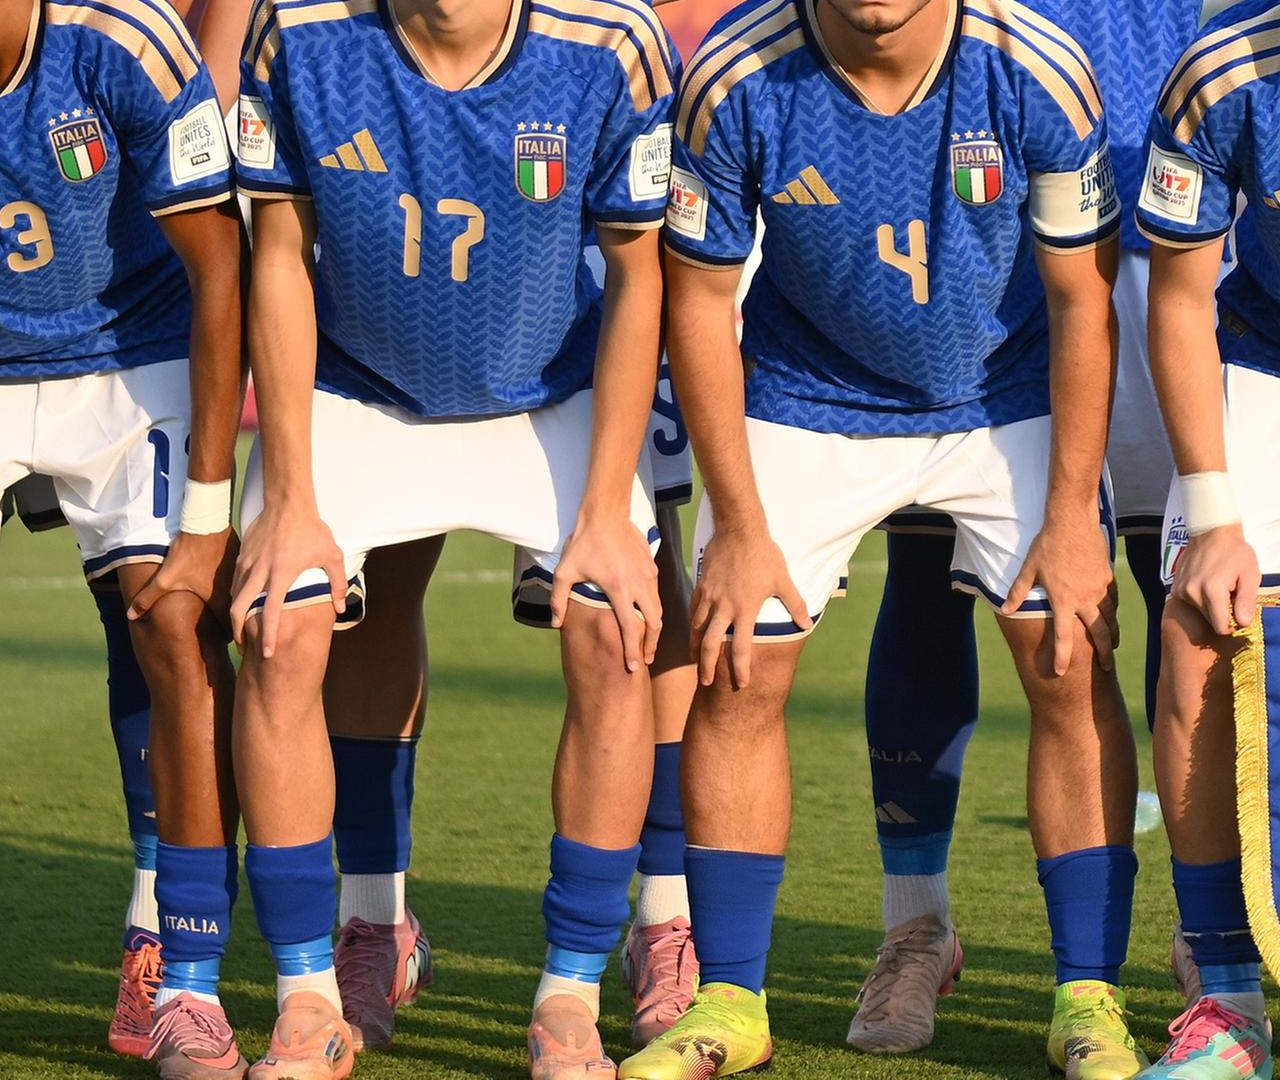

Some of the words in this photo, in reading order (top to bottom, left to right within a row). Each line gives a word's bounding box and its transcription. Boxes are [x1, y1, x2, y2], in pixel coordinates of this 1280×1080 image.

[54, 123, 98, 146] ITALIA
[180, 124, 211, 147] UNITES
[519, 139, 562, 155] ITALIA
[955, 147, 998, 162] ITALIA
[1152, 166, 1191, 192] U17
[399, 194, 485, 282] 17
[876, 219, 930, 305] 4
[165, 915, 219, 935] ITALIA
